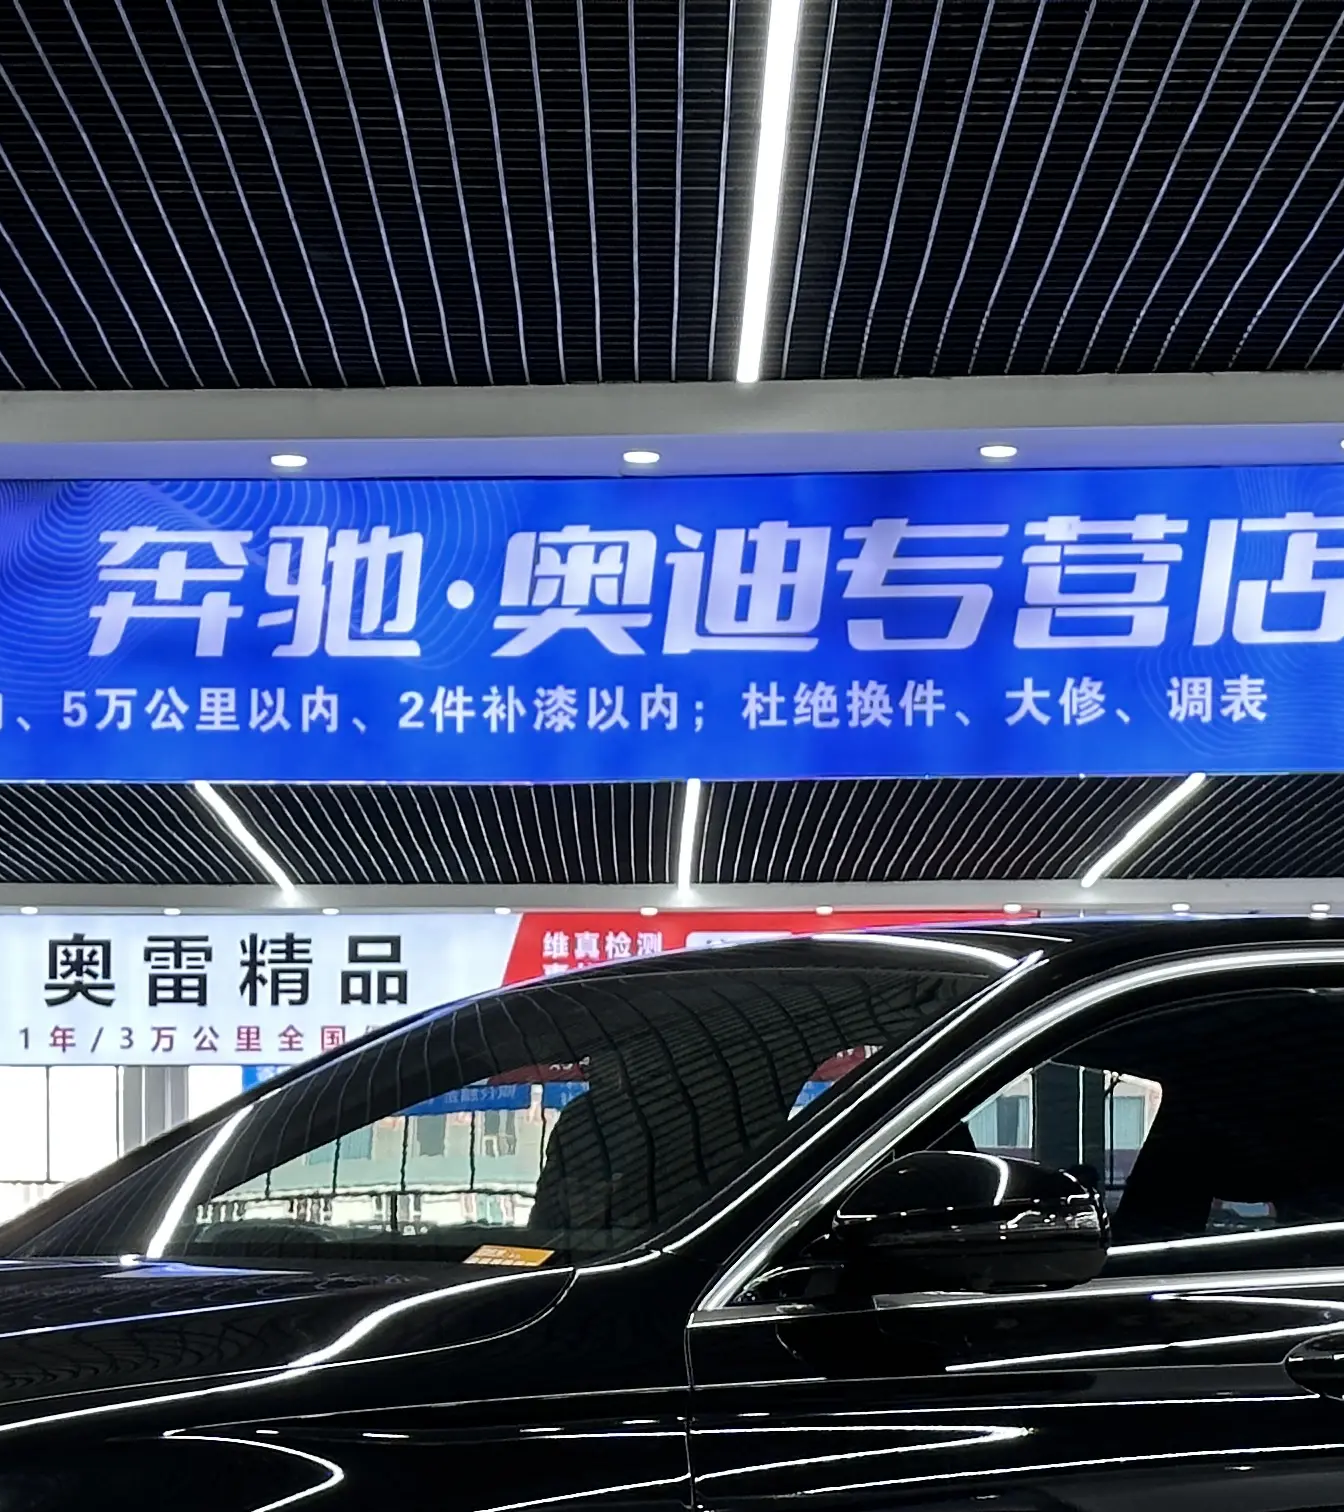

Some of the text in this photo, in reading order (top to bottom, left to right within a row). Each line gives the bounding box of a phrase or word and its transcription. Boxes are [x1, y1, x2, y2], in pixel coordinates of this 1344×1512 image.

[542, 930, 663, 958] 维真检测
[43, 932, 412, 1009] 奥雷精品
